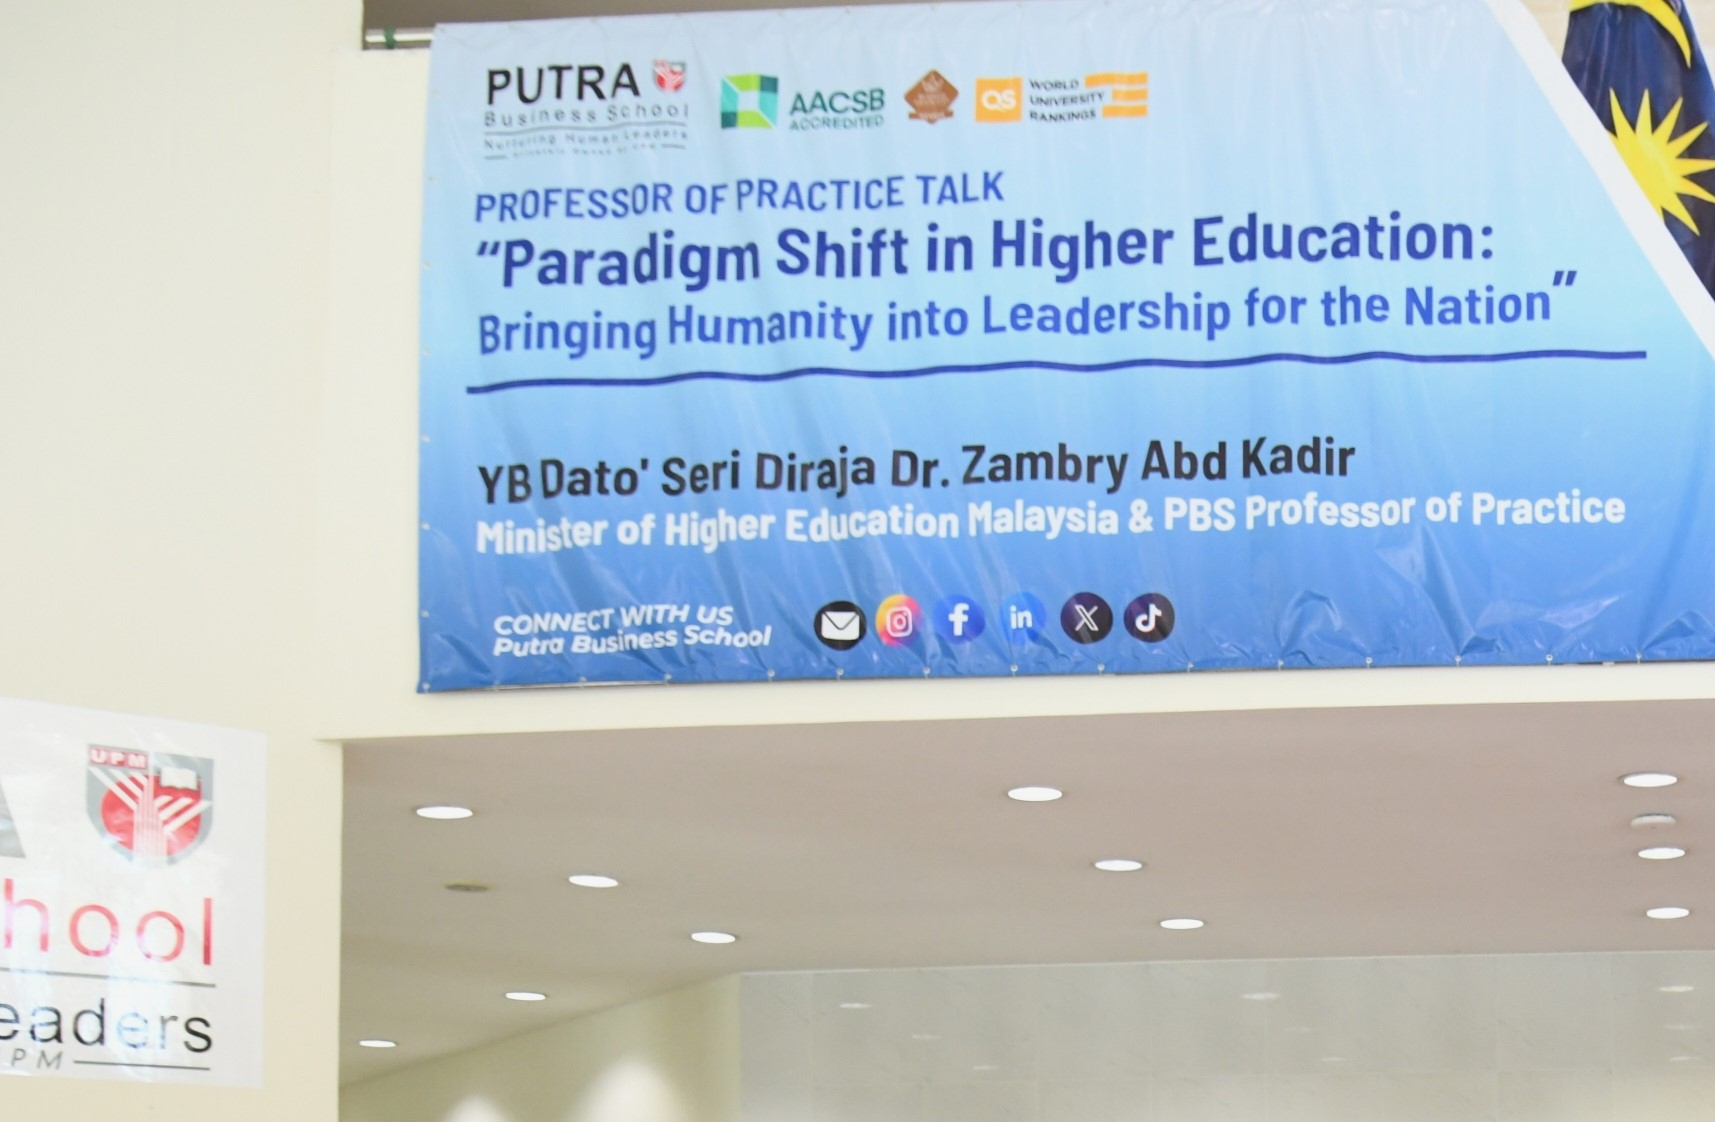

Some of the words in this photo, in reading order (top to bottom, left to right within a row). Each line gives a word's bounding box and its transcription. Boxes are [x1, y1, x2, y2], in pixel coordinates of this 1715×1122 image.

[486, 63, 640, 105] PUTRA
[1029, 78, 1079, 91] WORLD
[484, 106, 598, 127] Business
[606, 102, 689, 119] School
[789, 88, 886, 116] AACSB
[981, 89, 1017, 113] QS
[1029, 91, 1105, 108] UNIVERSITY
[789, 114, 884, 132] ACCREDITED
[1029, 108, 1097, 123] RANKINGS
[475, 183, 673, 222] PROFESSOR
[685, 184, 729, 214] OF
[736, 175, 905, 212] PRACTICE
[916, 170, 1005, 206] TALK
[776, 227, 909, 279] Shift
[926, 222, 975, 272] in
[991, 216, 1175, 284] Higher
[1193, 210, 1495, 267] Education:
[479, 310, 657, 360] Bringing
[668, 301, 873, 352] Humanity
[888, 300, 969, 341] into
[983, 291, 1231, 342] Leadership
[1245, 287, 1307, 327] for
[1321, 286, 1390, 328] the
[477, 463, 533, 505] YB
[540, 457, 649, 499] Dato'
[660, 449, 740, 497] Seri
[754, 445, 876, 499] Diraja
[891, 448, 950, 489] Dr.
[961, 443, 1128, 494] Zambry
[1141, 438, 1227, 482] Abd
[1242, 435, 1357, 479] Kadir
[476, 518, 609, 556] Minister
[616, 512, 657, 546] of
[664, 508, 776, 555] Higher
[786, 502, 959, 545] Education
[967, 498, 1120, 541] Malaysia
[1128, 500, 1154, 534] &
[1164, 496, 1236, 533] PBS
[1245, 491, 1416, 531] Professor
[1425, 489, 1463, 523] of
[1472, 488, 1627, 526] Practice
[493, 606, 616, 636] CONNECT
[620, 603, 692, 631] WITH
[696, 604, 735, 628] US
[492, 633, 570, 658] Putra
[574, 628, 679, 655] Business
[683, 624, 772, 649] School
[90, 747, 147, 769] UPM
